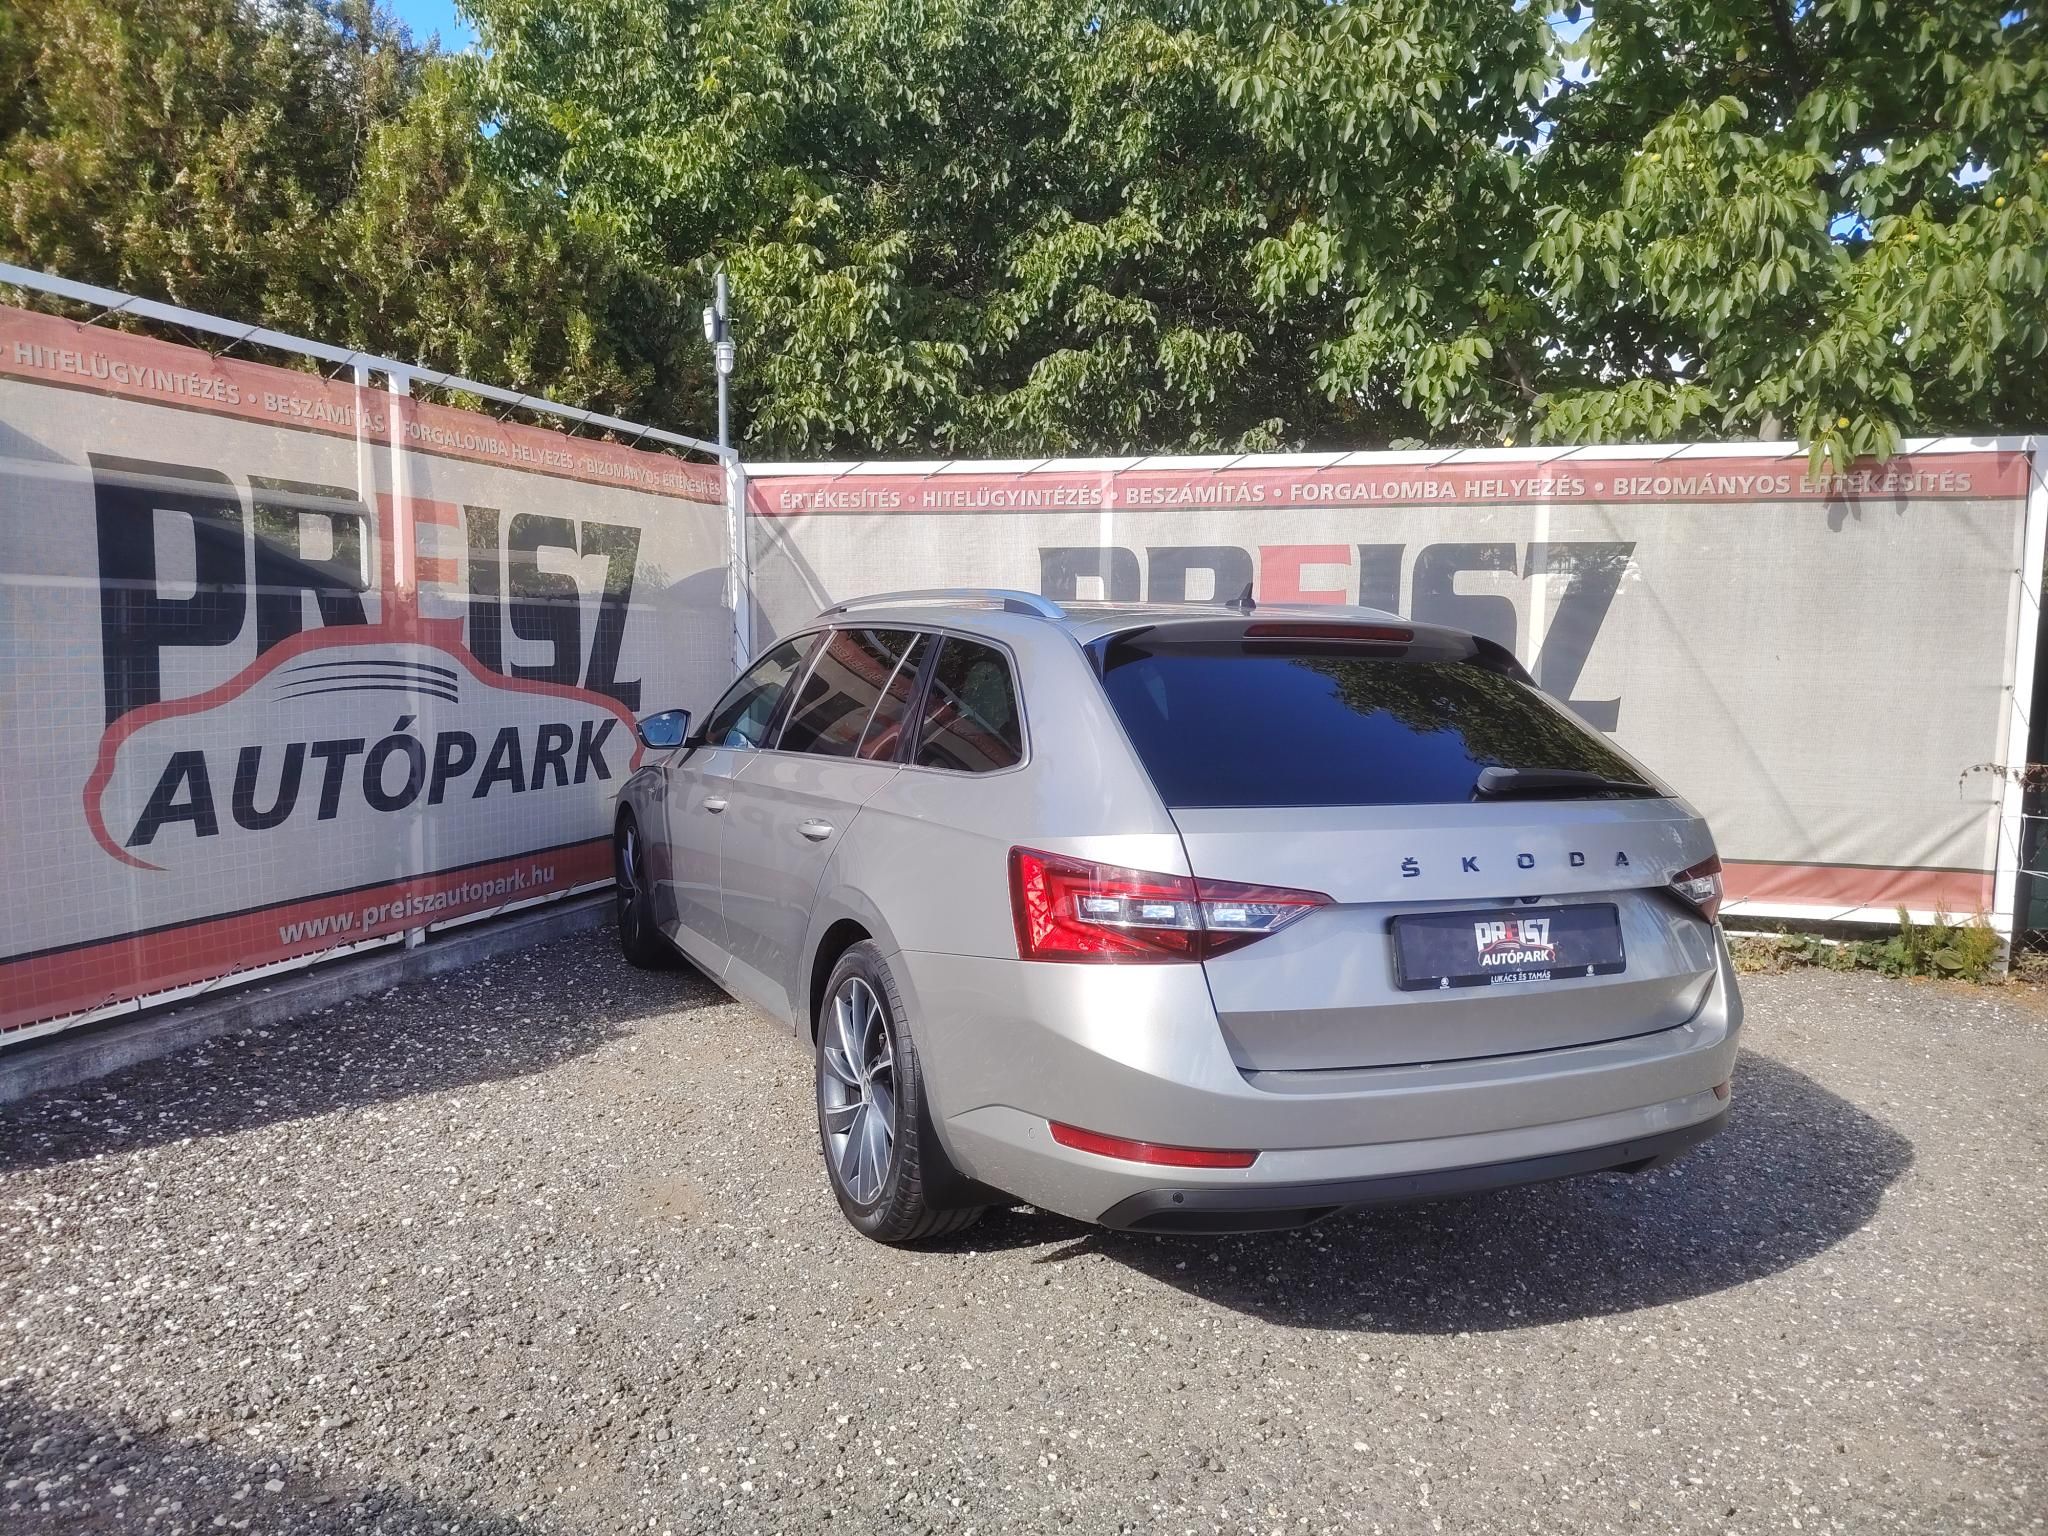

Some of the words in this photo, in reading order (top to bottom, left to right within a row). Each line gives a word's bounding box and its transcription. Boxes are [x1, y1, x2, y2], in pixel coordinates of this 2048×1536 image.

[13, 340, 243, 406] HITELÜGYINTÉZÉS
[403, 421, 509, 458] FORGALOMBA
[511, 443, 575, 470] HELYEZÉS
[779, 488, 901, 510] ÉRTÉKESÍTÉS
[922, 486, 1104, 508] HITELÜGYINTÉZÉS
[1125, 482, 1266, 505] BESZÁMÍTÁS
[1290, 481, 1457, 501] FORGALOMBA
[1464, 474, 1586, 499] HELYEZÉS
[1613, 472, 1791, 496] BIZOMÁNYOS
[1799, 469, 1974, 494] ÉRTÉKESÍTÉS
[87, 452, 642, 730] PREISZ
[1038, 541, 1637, 733] EISZ
[125, 715, 617, 848] AUTÓPARK
[278, 863, 555, 946] www.preiszautopark.hu
[1401, 851, 1630, 878] ŠKODA
[1474, 918, 1554, 952] PREISZ
[1481, 949, 1550, 967] AUTÓPARK
